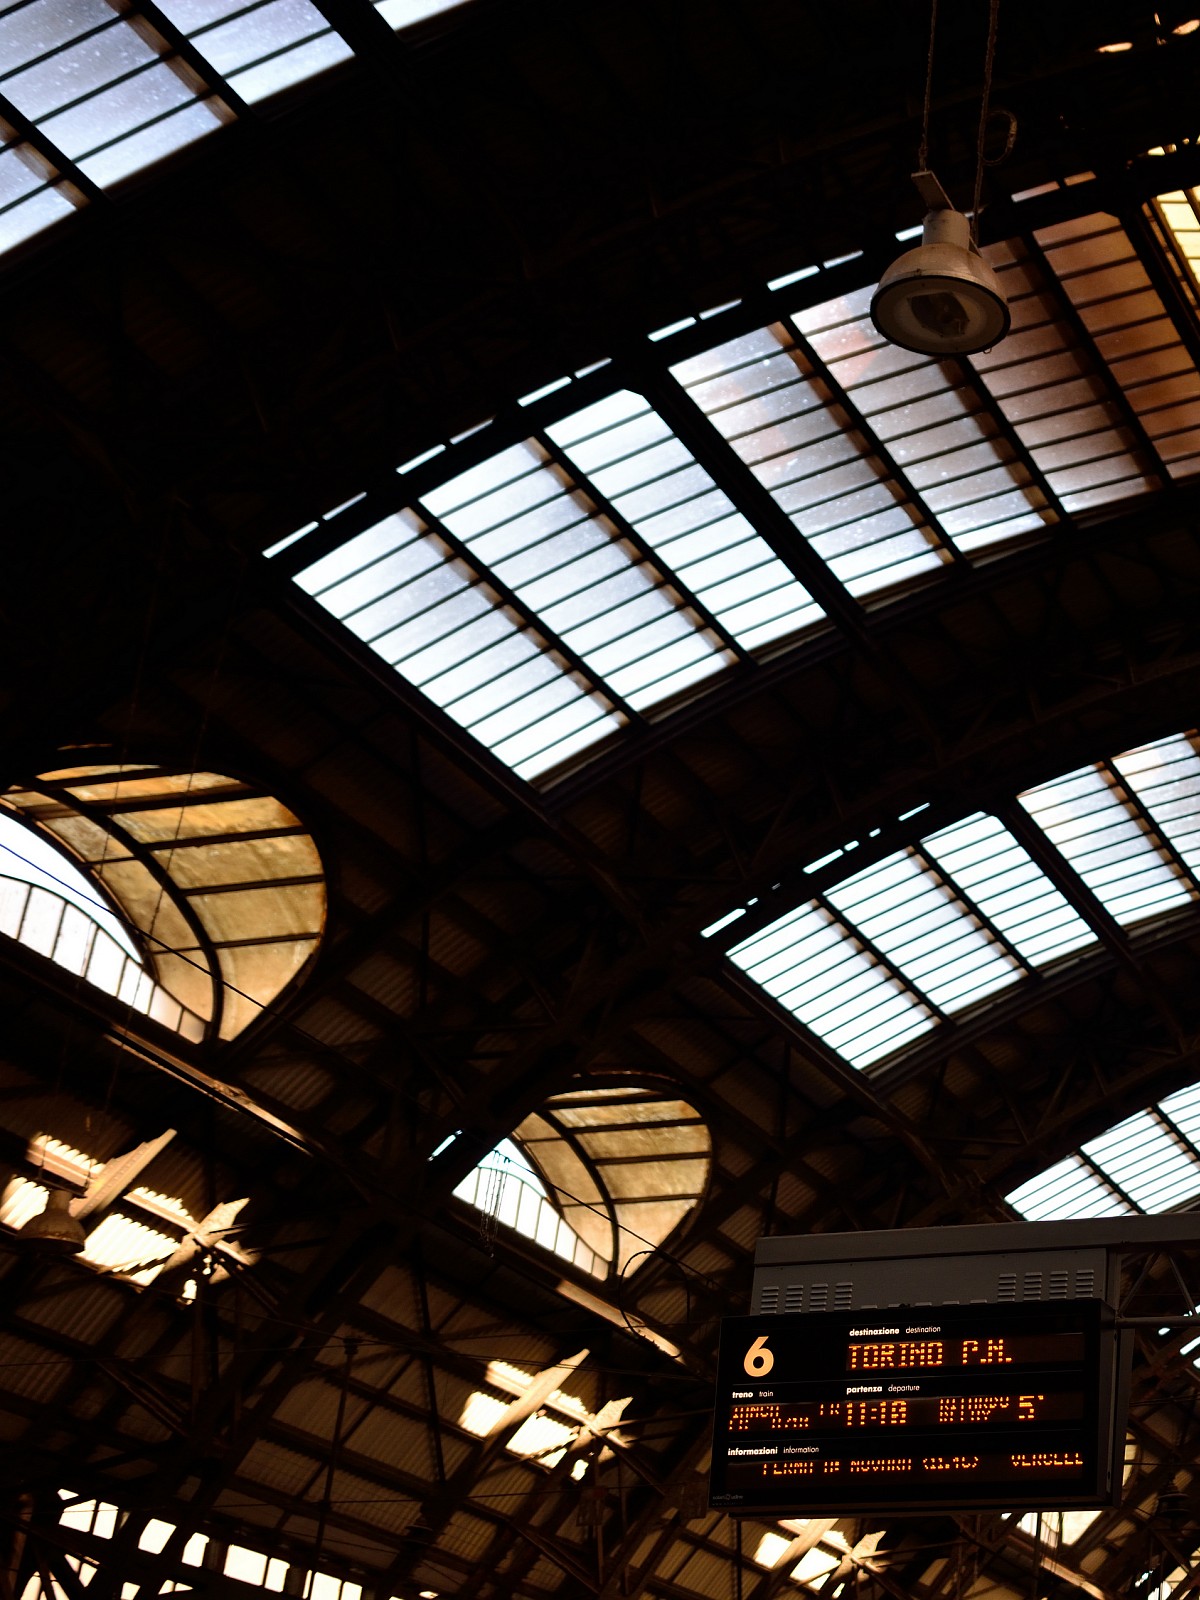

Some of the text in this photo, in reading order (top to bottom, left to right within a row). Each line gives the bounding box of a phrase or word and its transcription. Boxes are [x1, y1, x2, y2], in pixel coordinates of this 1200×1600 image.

[848, 1324, 941, 1338] destinazione destination
[743, 1335, 775, 1378] 6
[848, 1341, 944, 1369] TORINO
[731, 1390, 774, 1399] treno train
[846, 1382, 921, 1396] partenza departure
[727, 1444, 820, 1457] informazioni information
